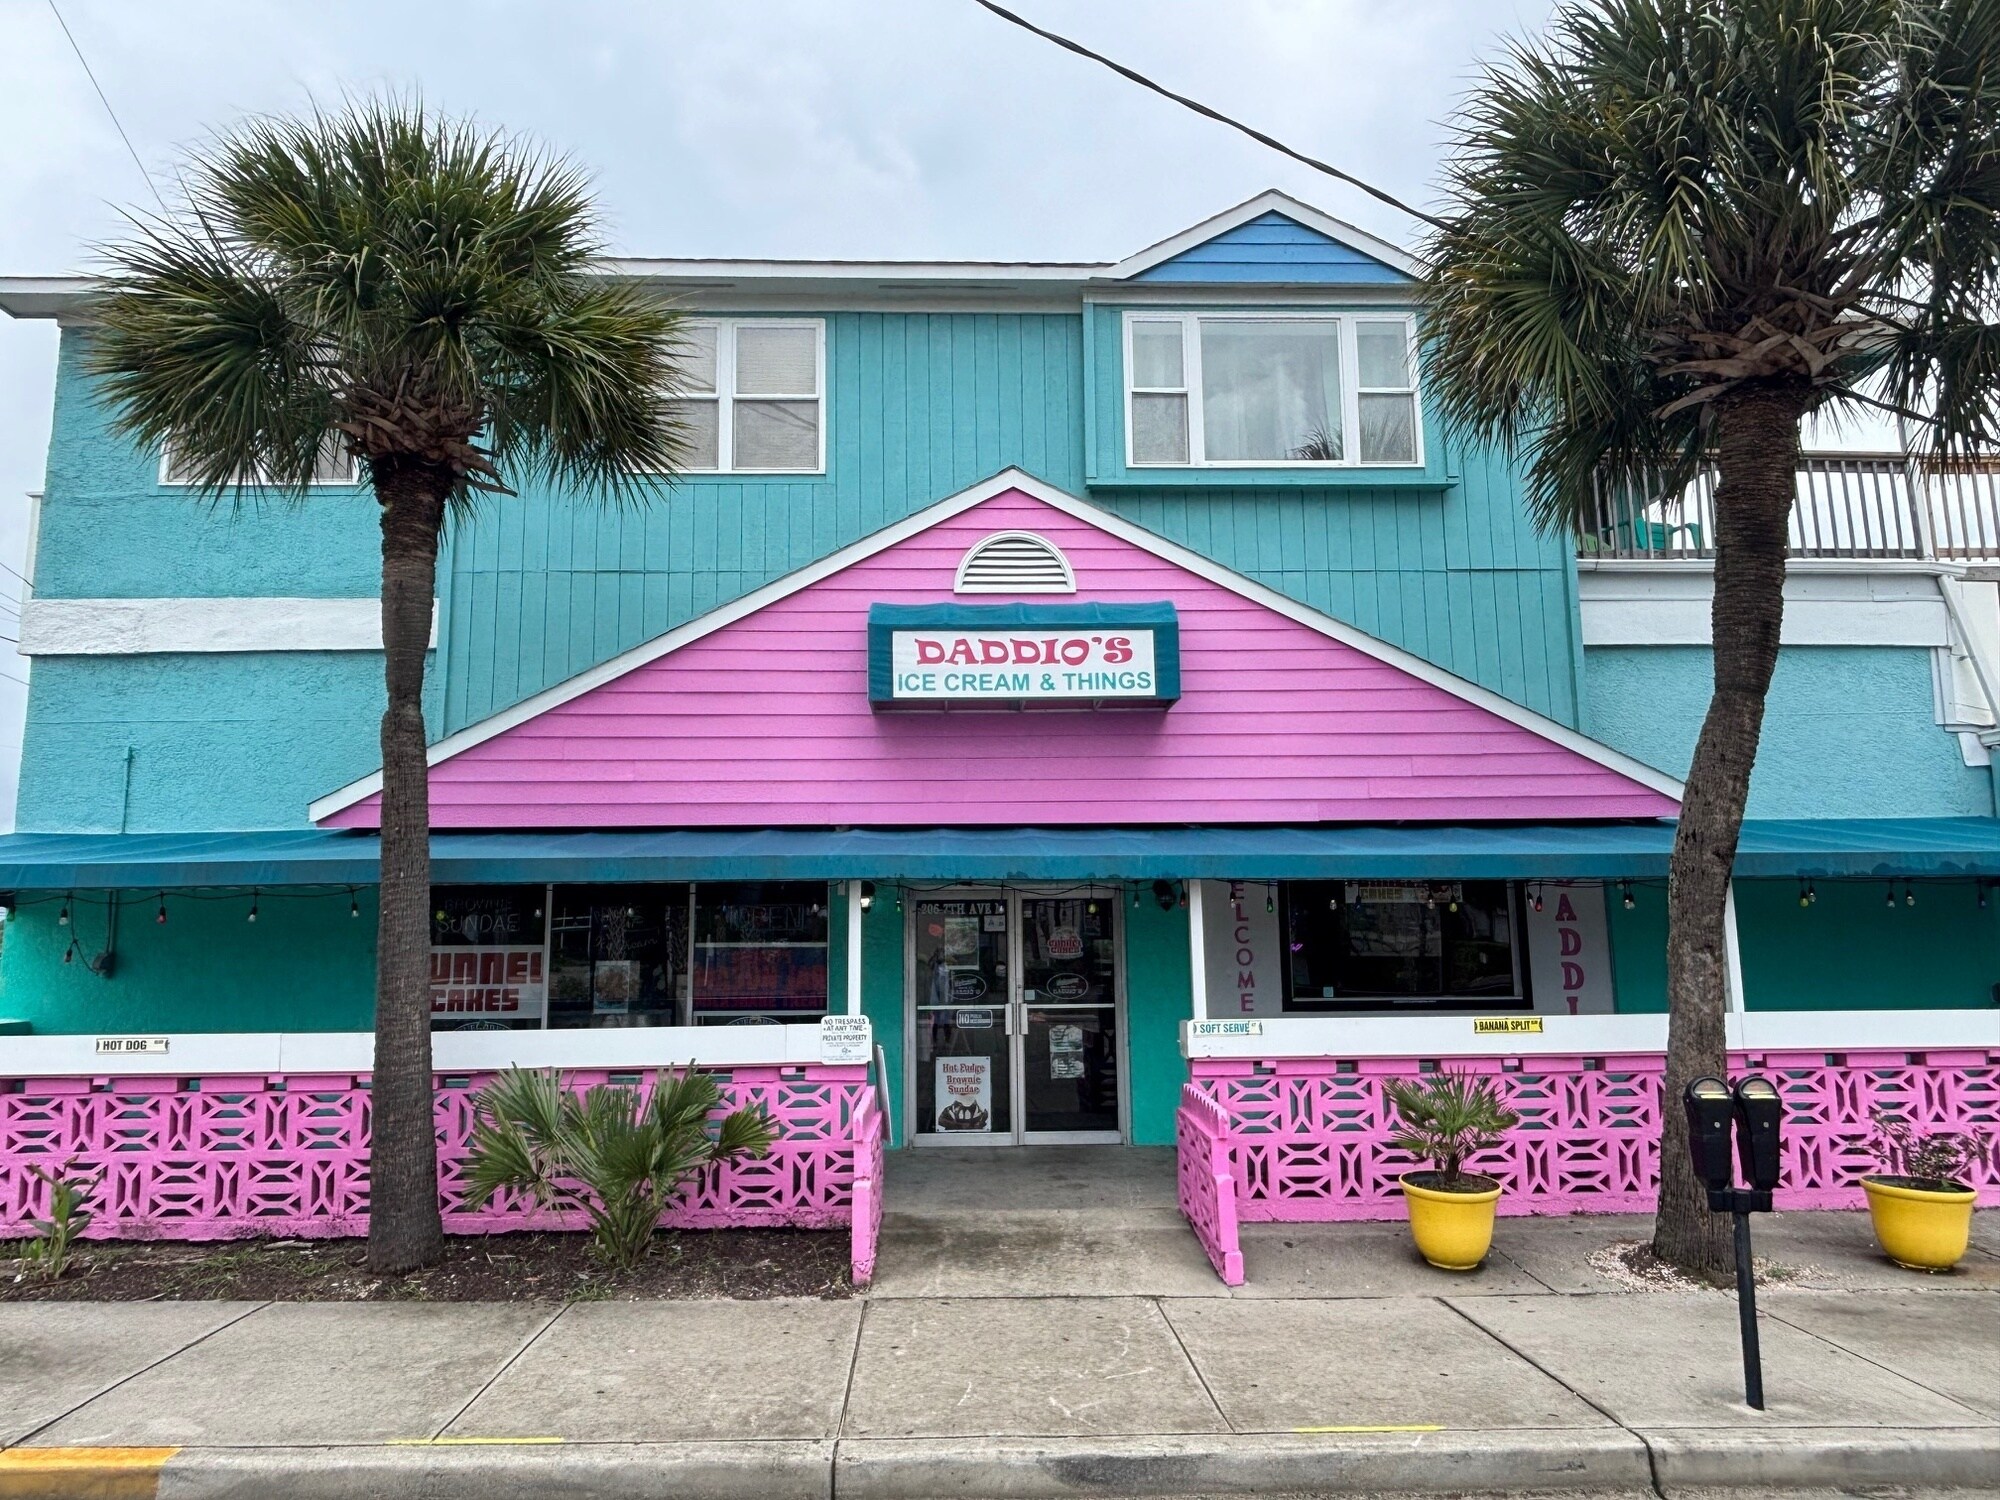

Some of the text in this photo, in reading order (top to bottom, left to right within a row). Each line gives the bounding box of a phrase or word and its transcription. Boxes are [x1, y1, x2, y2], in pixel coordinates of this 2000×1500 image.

[914, 636, 1134, 666] DADDIO'S
[898, 671, 1151, 692] ICE CREAM & THINGS
[969, 903, 992, 915] AVE
[438, 913, 520, 933] SUNDAE
[1231, 881, 1255, 1012] ELCOME
[431, 989, 520, 1012] CAKES
[1200, 1023, 1221, 1033] SOFT
[1223, 1023, 1249, 1033] SERVE
[1479, 1020, 1530, 1031] BANANA SPLIT
[103, 1040, 122, 1050] HOT
[126, 1040, 147, 1050] DOG
[942, 1063, 985, 1074] Hot Fudge
[946, 1075, 981, 1085] Brownie
[948, 1085, 980, 1095] Sundae
